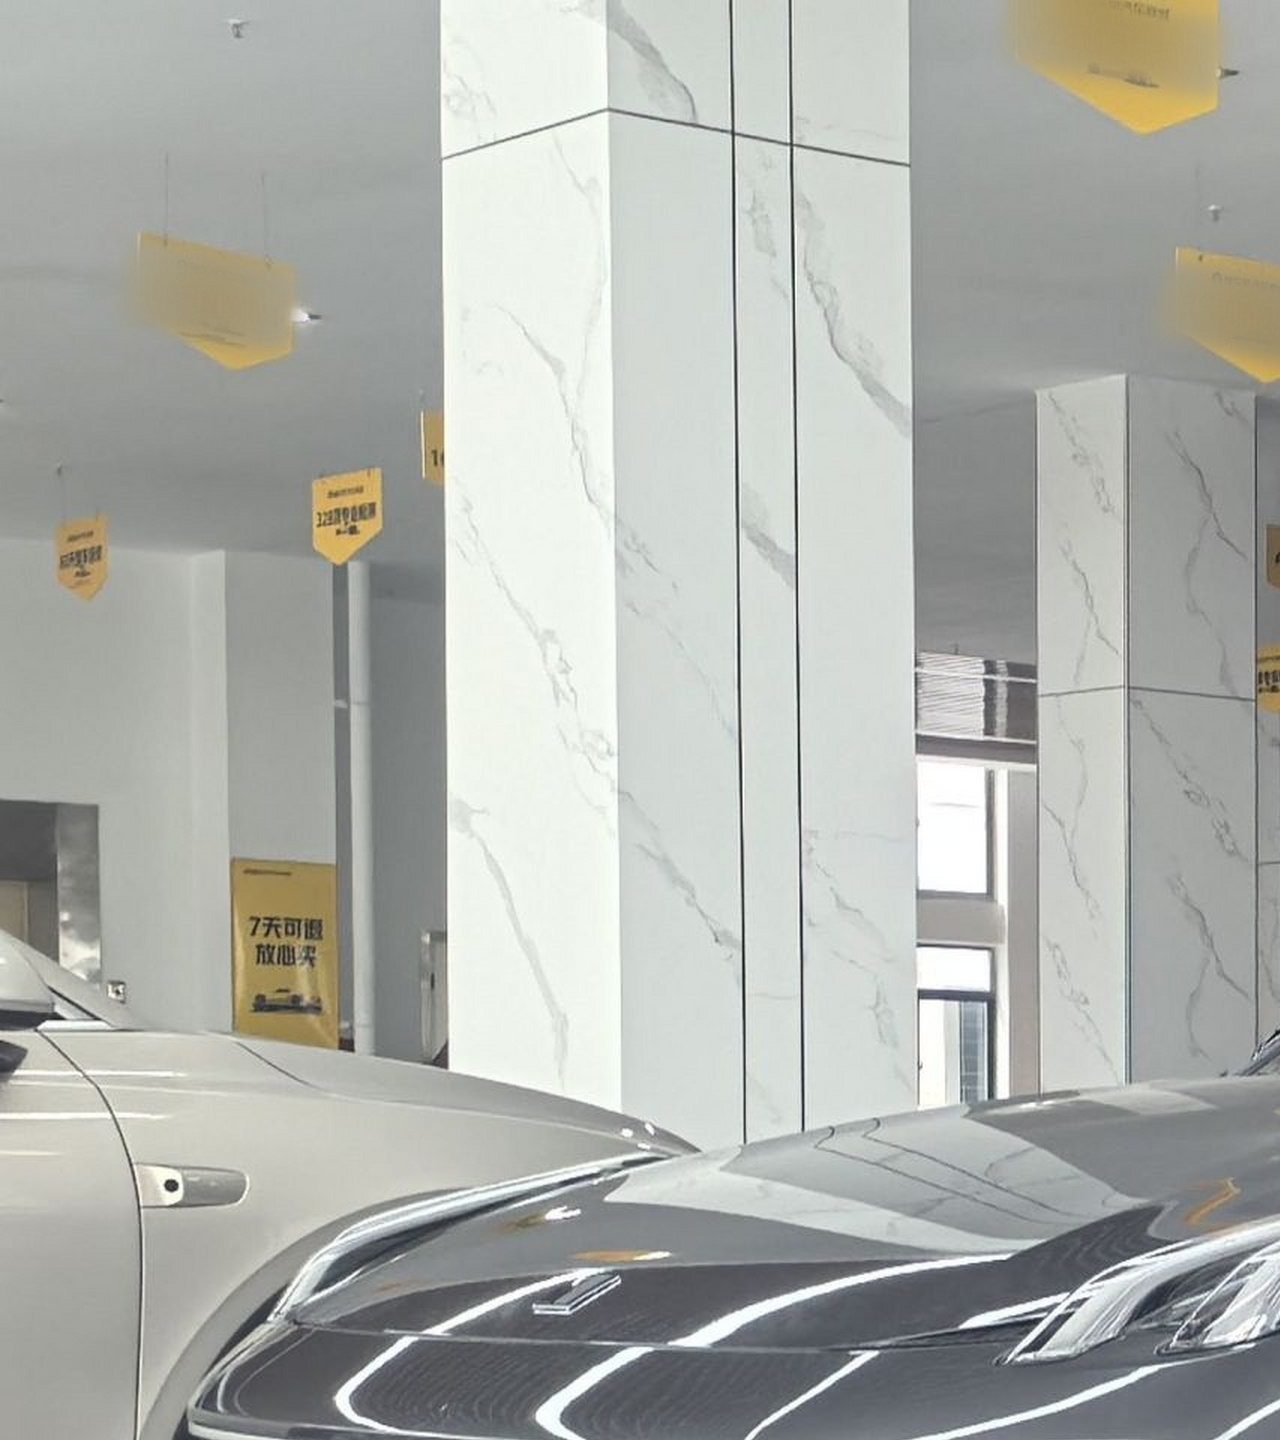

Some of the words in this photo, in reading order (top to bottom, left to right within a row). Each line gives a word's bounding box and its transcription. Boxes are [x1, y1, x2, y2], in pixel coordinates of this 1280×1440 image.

[249, 915, 324, 941] 7天可退
[255, 943, 317, 968] 放心买
